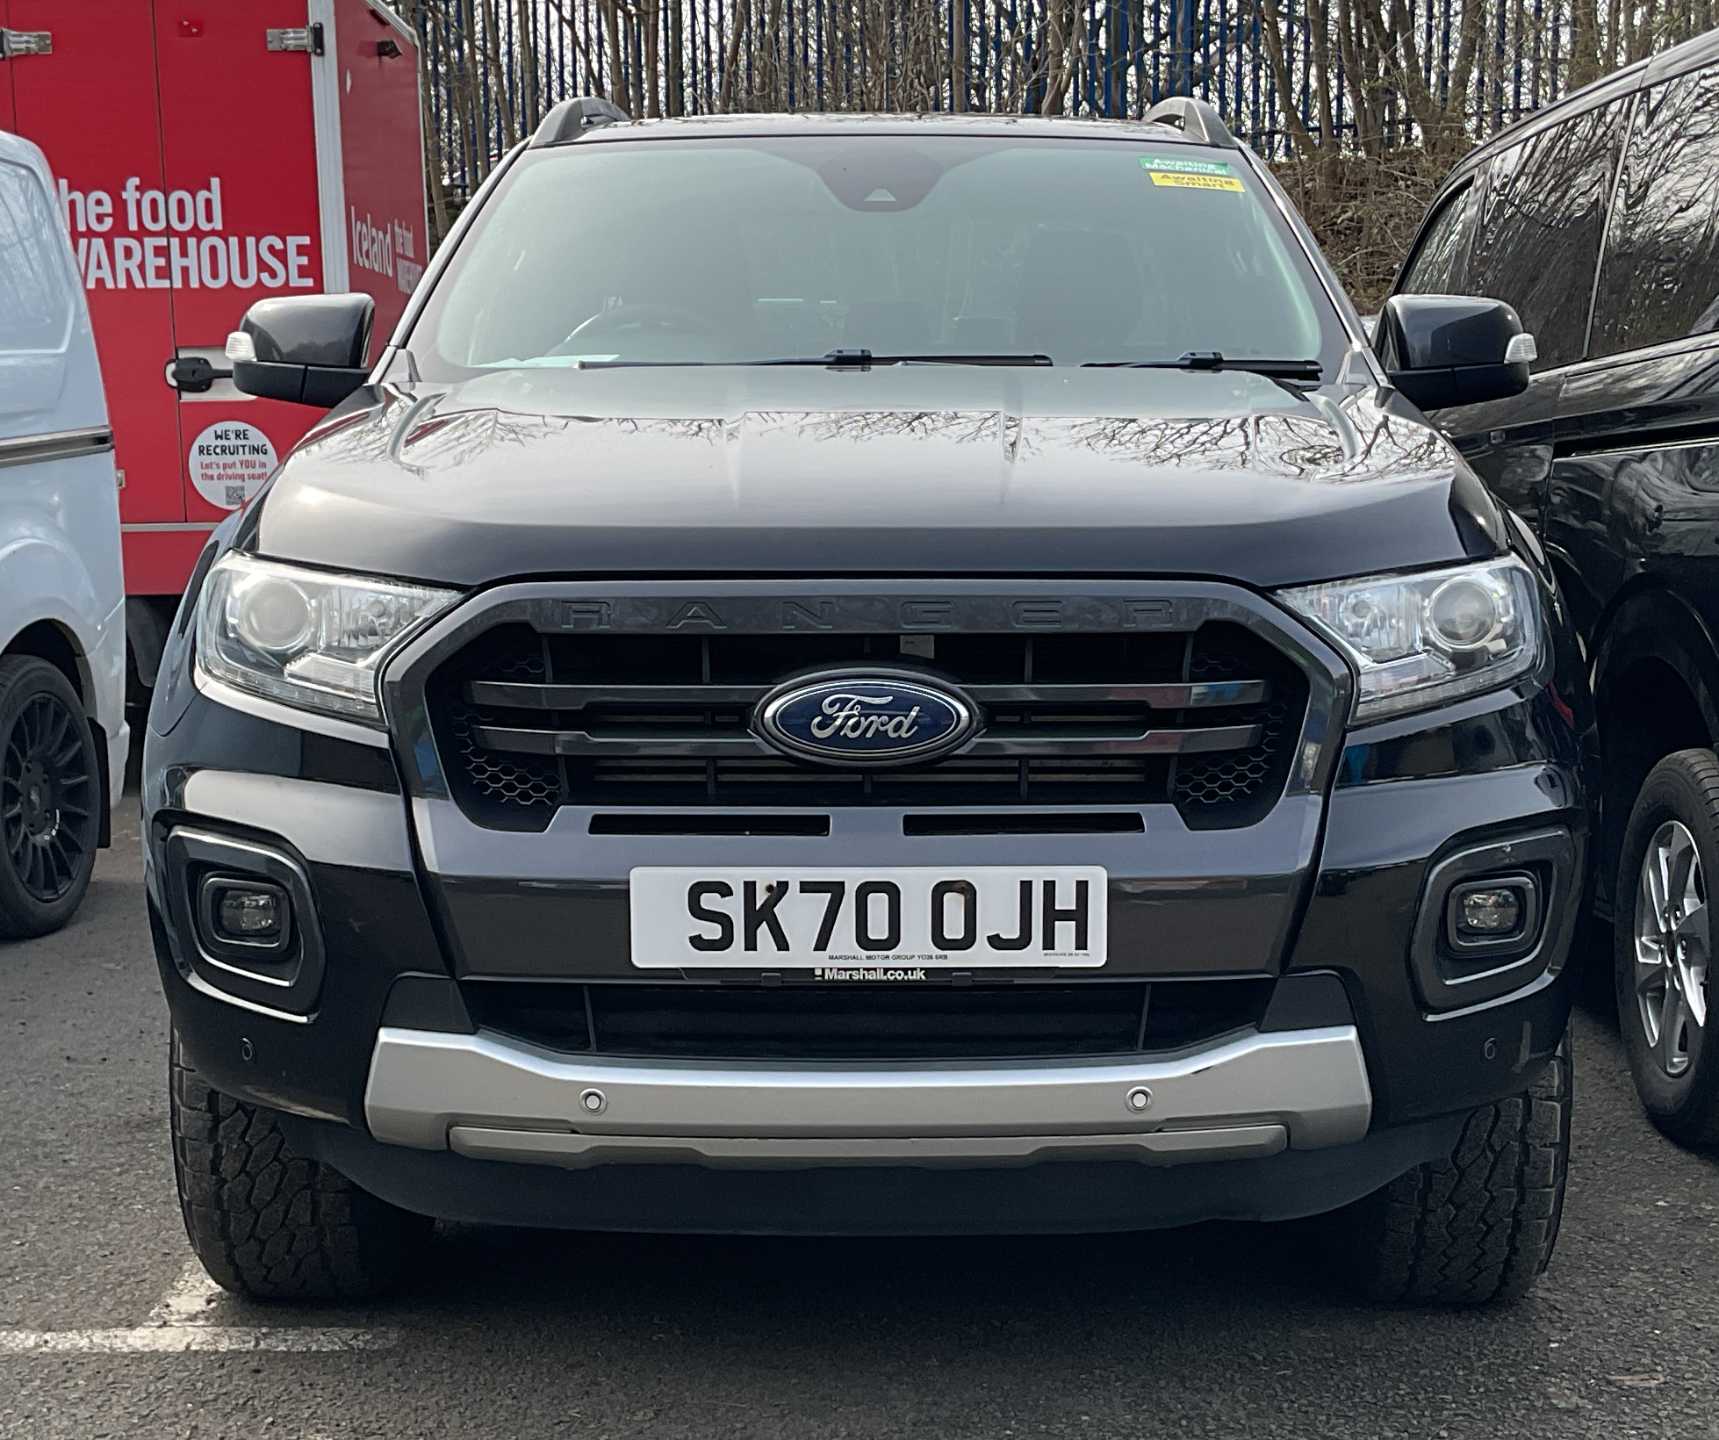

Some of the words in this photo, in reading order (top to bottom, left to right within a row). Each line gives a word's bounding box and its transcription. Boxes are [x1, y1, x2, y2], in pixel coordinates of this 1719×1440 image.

[57, 178, 114, 232] he
[121, 176, 224, 232] food
[351, 205, 393, 278] Iceland
[214, 429, 250, 441] WE'RE
[198, 444, 268, 456] RECRUITING
[200, 461, 220, 470] Let's
[222, 461, 237, 472] put
[238, 459, 257, 469] YOU
[258, 459, 267, 469] in
[201, 472, 215, 481] the
[216, 471, 246, 482] driving
[561, 600, 1174, 629] RANGER
[810, 693, 922, 739] Ford
[687, 880, 902, 953] SK70
[930, 879, 1090, 952] OJH
[824, 968, 927, 981] Marshall.co.uk
